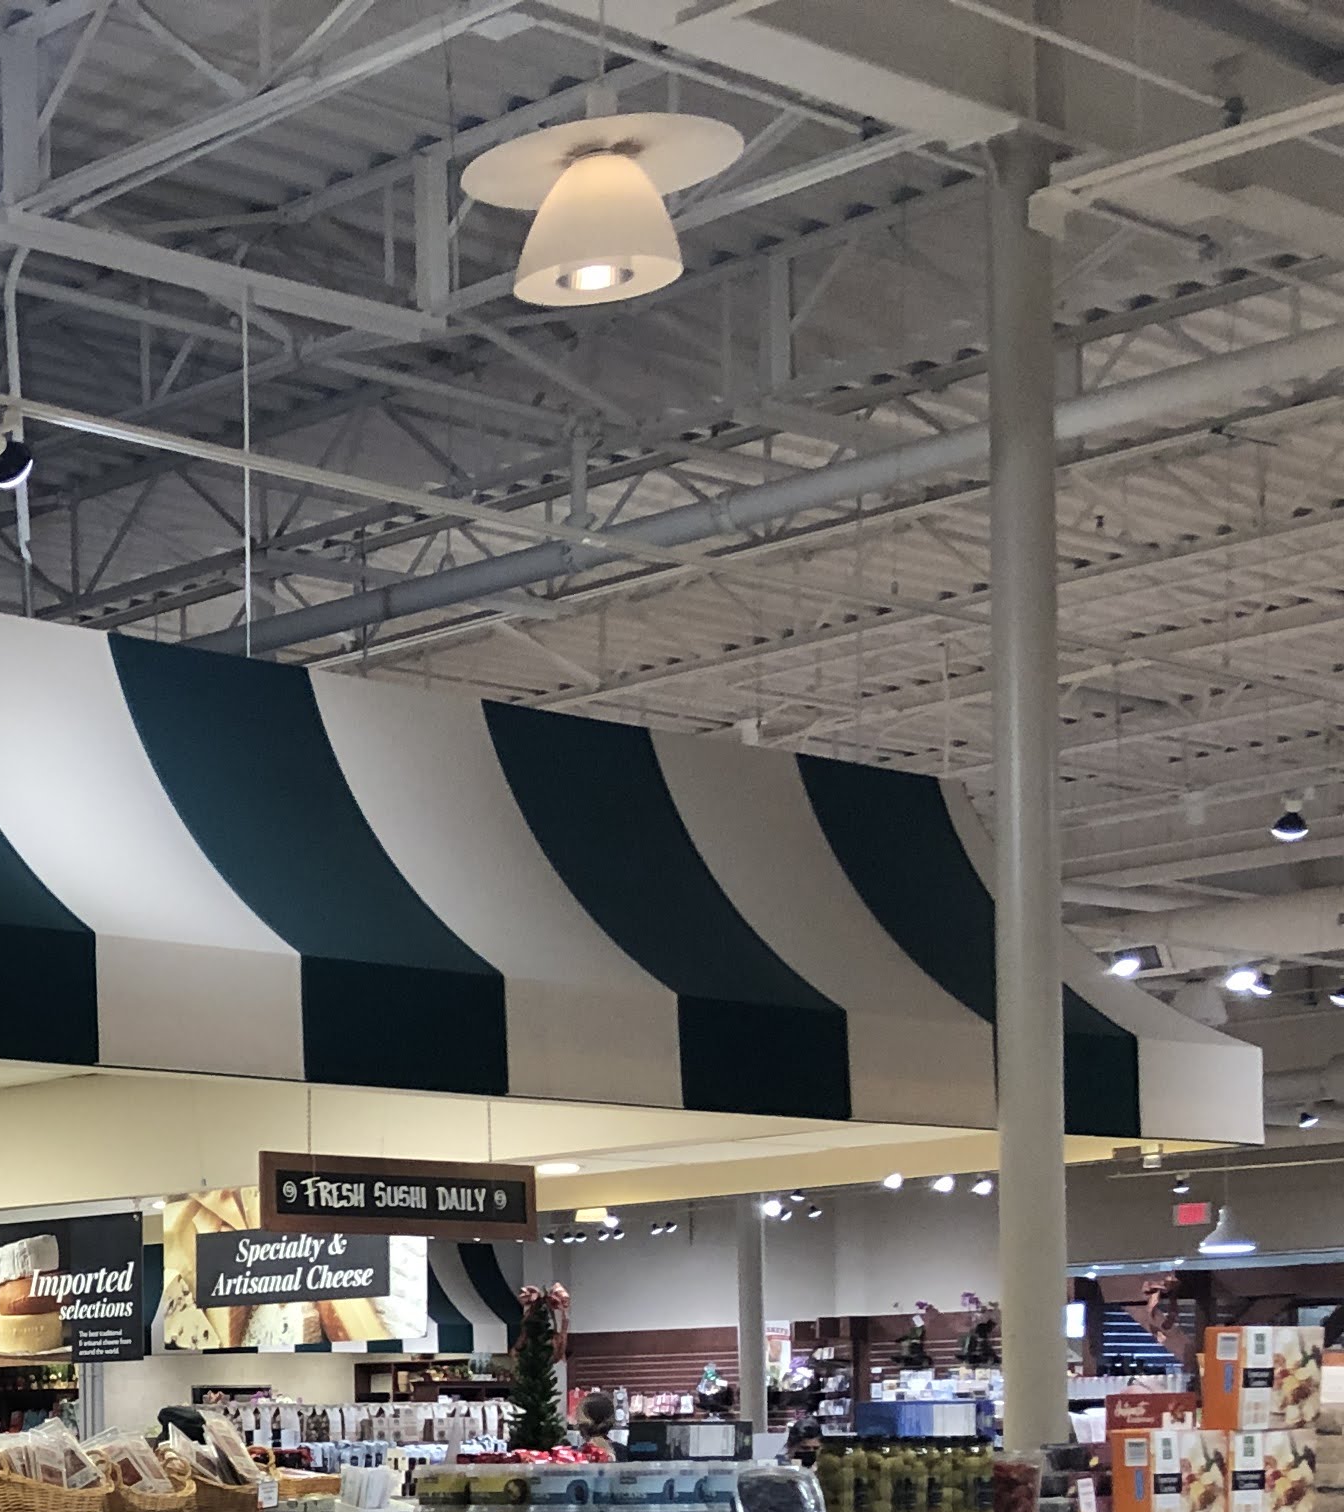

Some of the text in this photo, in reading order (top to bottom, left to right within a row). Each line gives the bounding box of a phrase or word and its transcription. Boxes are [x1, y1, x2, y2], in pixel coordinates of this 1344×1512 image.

[300, 1176, 487, 1213] FRESH SUSHI DAILY
[235, 1233, 348, 1267] Specialty &
[28, 1261, 135, 1303] Imported
[211, 1264, 374, 1297] Artisanal Cheese
[58, 1298, 134, 1321] selections
